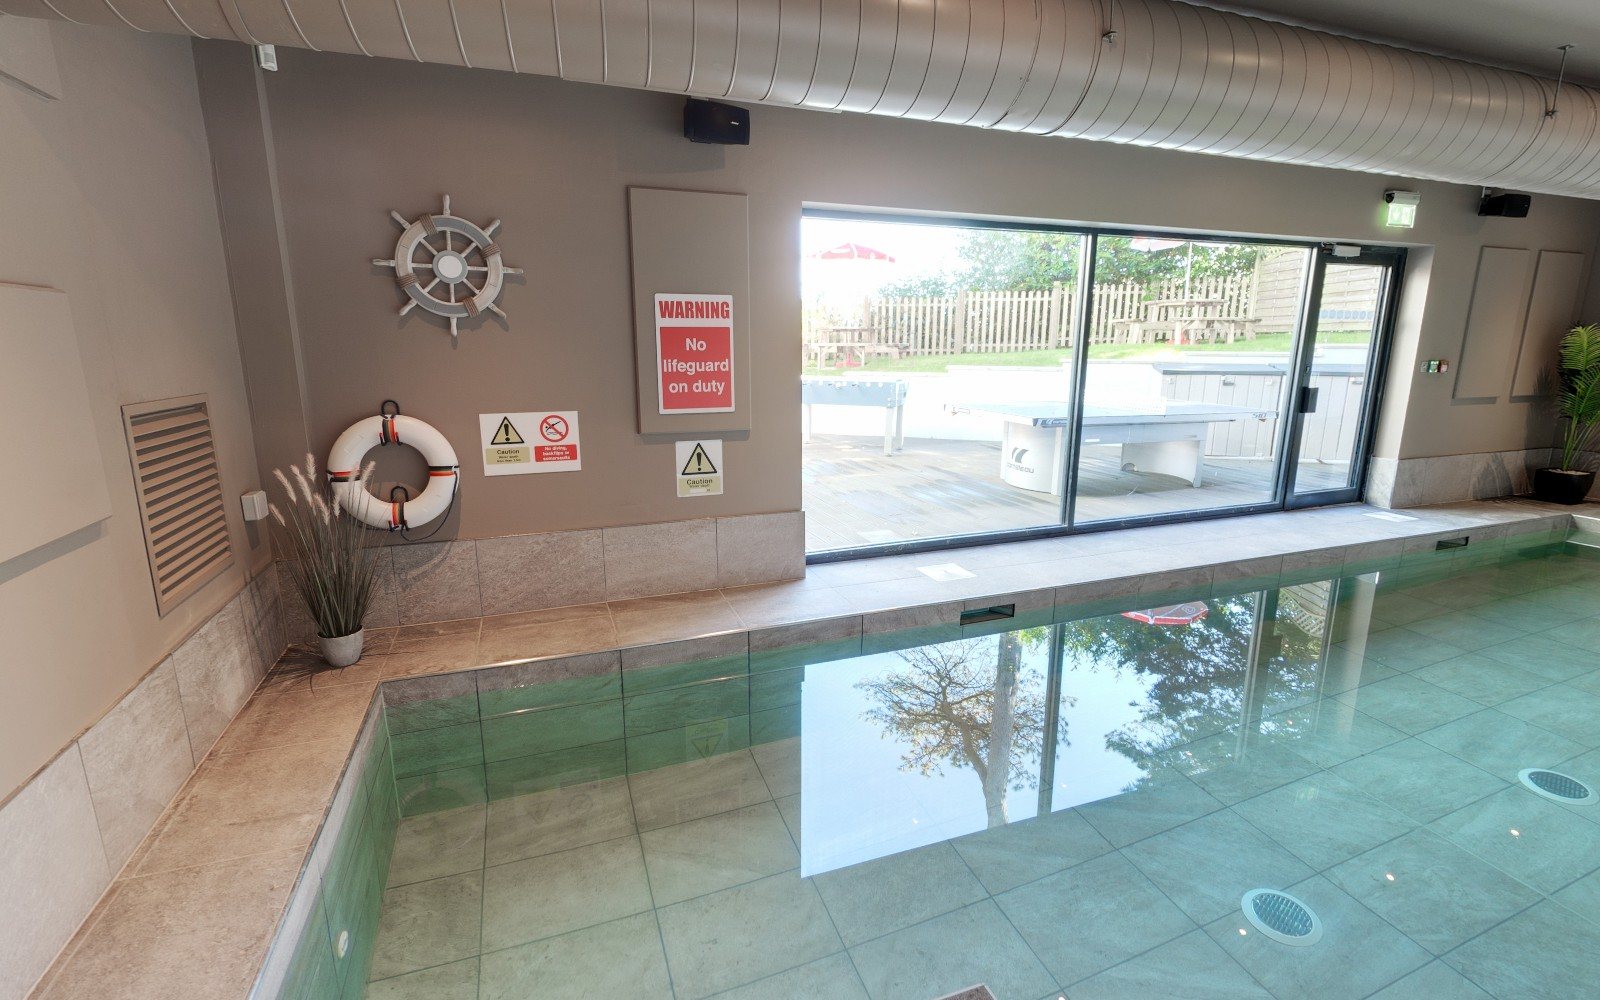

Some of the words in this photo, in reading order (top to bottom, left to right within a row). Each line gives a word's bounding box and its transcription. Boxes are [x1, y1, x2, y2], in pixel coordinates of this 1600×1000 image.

[659, 301, 730, 319] WARNING
[685, 338, 707, 351] No
[663, 359, 729, 375] lifeguard
[669, 382, 688, 393] on
[693, 380, 725, 395] duty
